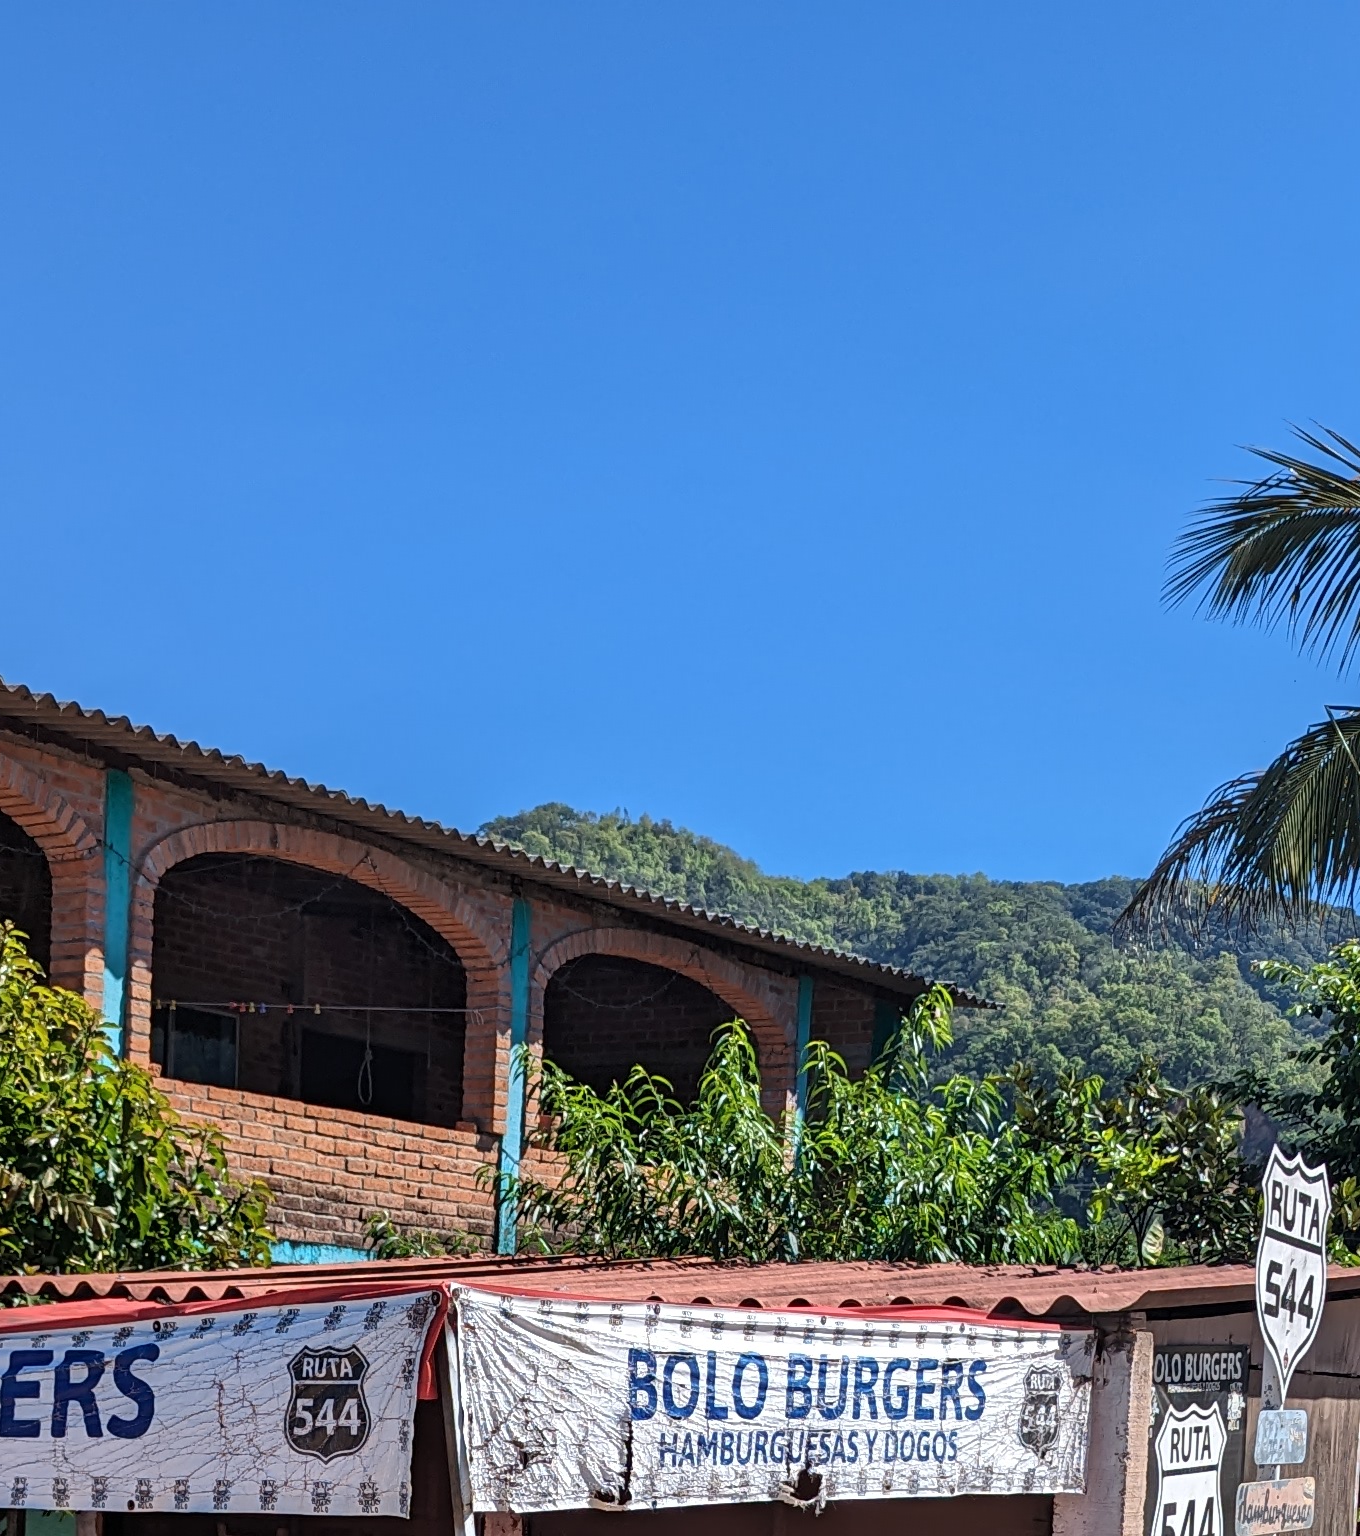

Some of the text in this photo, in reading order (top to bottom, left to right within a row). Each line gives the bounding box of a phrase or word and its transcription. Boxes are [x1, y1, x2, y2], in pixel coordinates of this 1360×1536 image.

[1270, 1180, 1320, 1243] RUTA
[1264, 1260, 1314, 1329] 544
[302, 1357, 354, 1379] RUTA
[628, 1347, 988, 1421] BOLO BURGERS
[1153, 1352, 1243, 1383] OLO BURGERS
[293, 1398, 362, 1436] 544
[659, 1430, 958, 1467] HAMBURGUESAS Y DOGOS
[1170, 1425, 1212, 1464] RUTA
